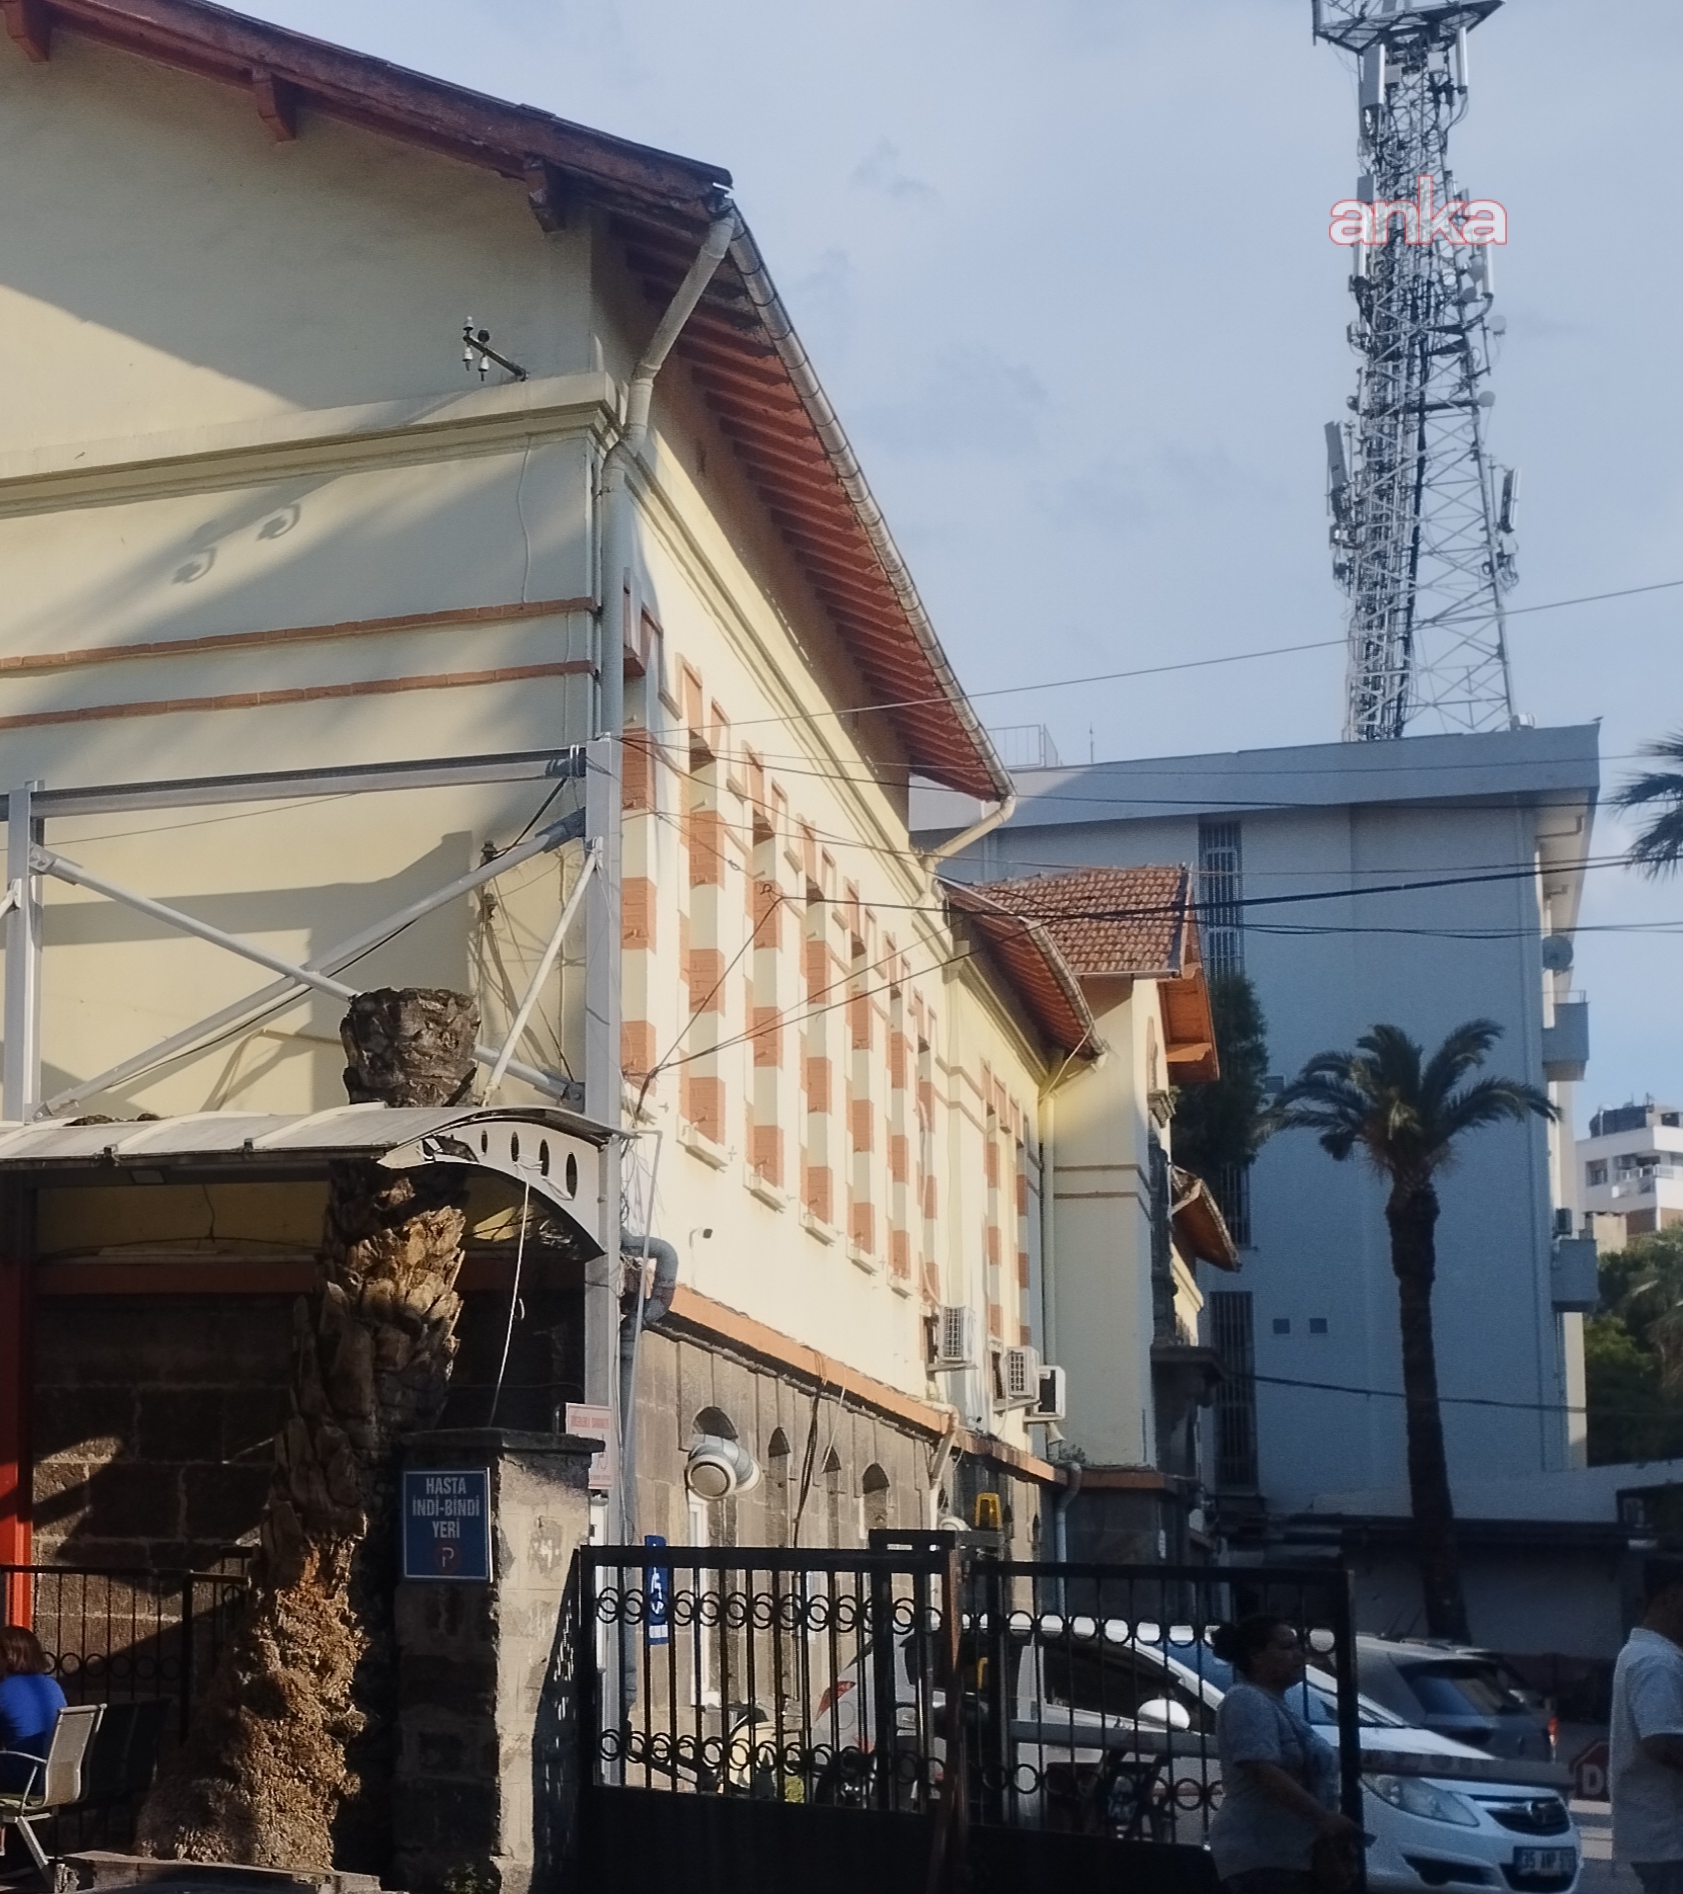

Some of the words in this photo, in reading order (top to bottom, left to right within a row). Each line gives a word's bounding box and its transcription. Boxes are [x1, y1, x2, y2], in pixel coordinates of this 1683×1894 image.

[426, 1477, 467, 1495] HASTA
[412, 1495, 480, 1517] İNDİ-BİNDİ
[432, 1517, 460, 1539] YERİ
